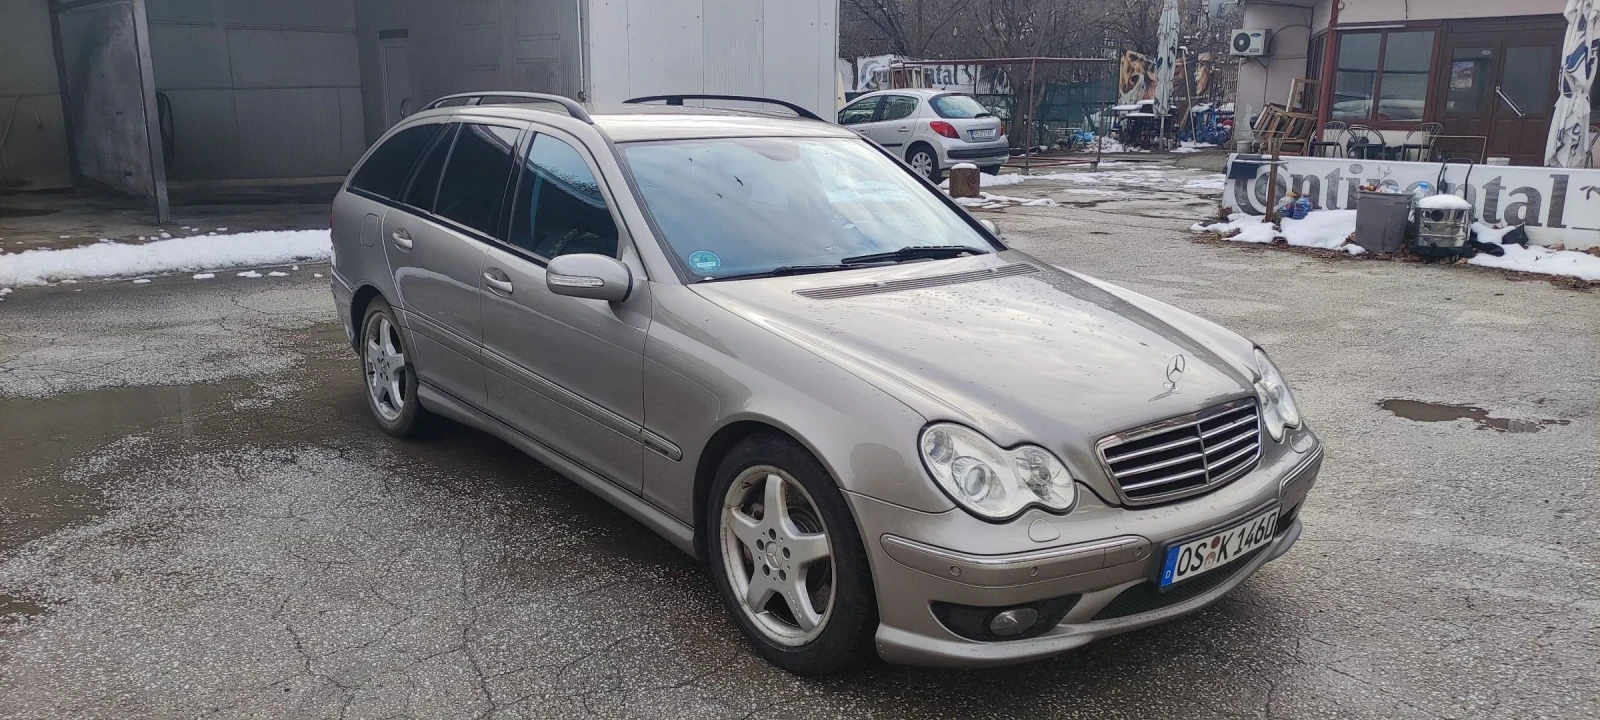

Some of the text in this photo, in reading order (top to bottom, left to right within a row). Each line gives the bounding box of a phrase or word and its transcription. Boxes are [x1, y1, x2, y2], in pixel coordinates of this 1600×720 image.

[1233, 162, 1570, 229] Contital
[1165, 570, 1172, 579] D
[1176, 511, 1278, 577] OS K 1460
